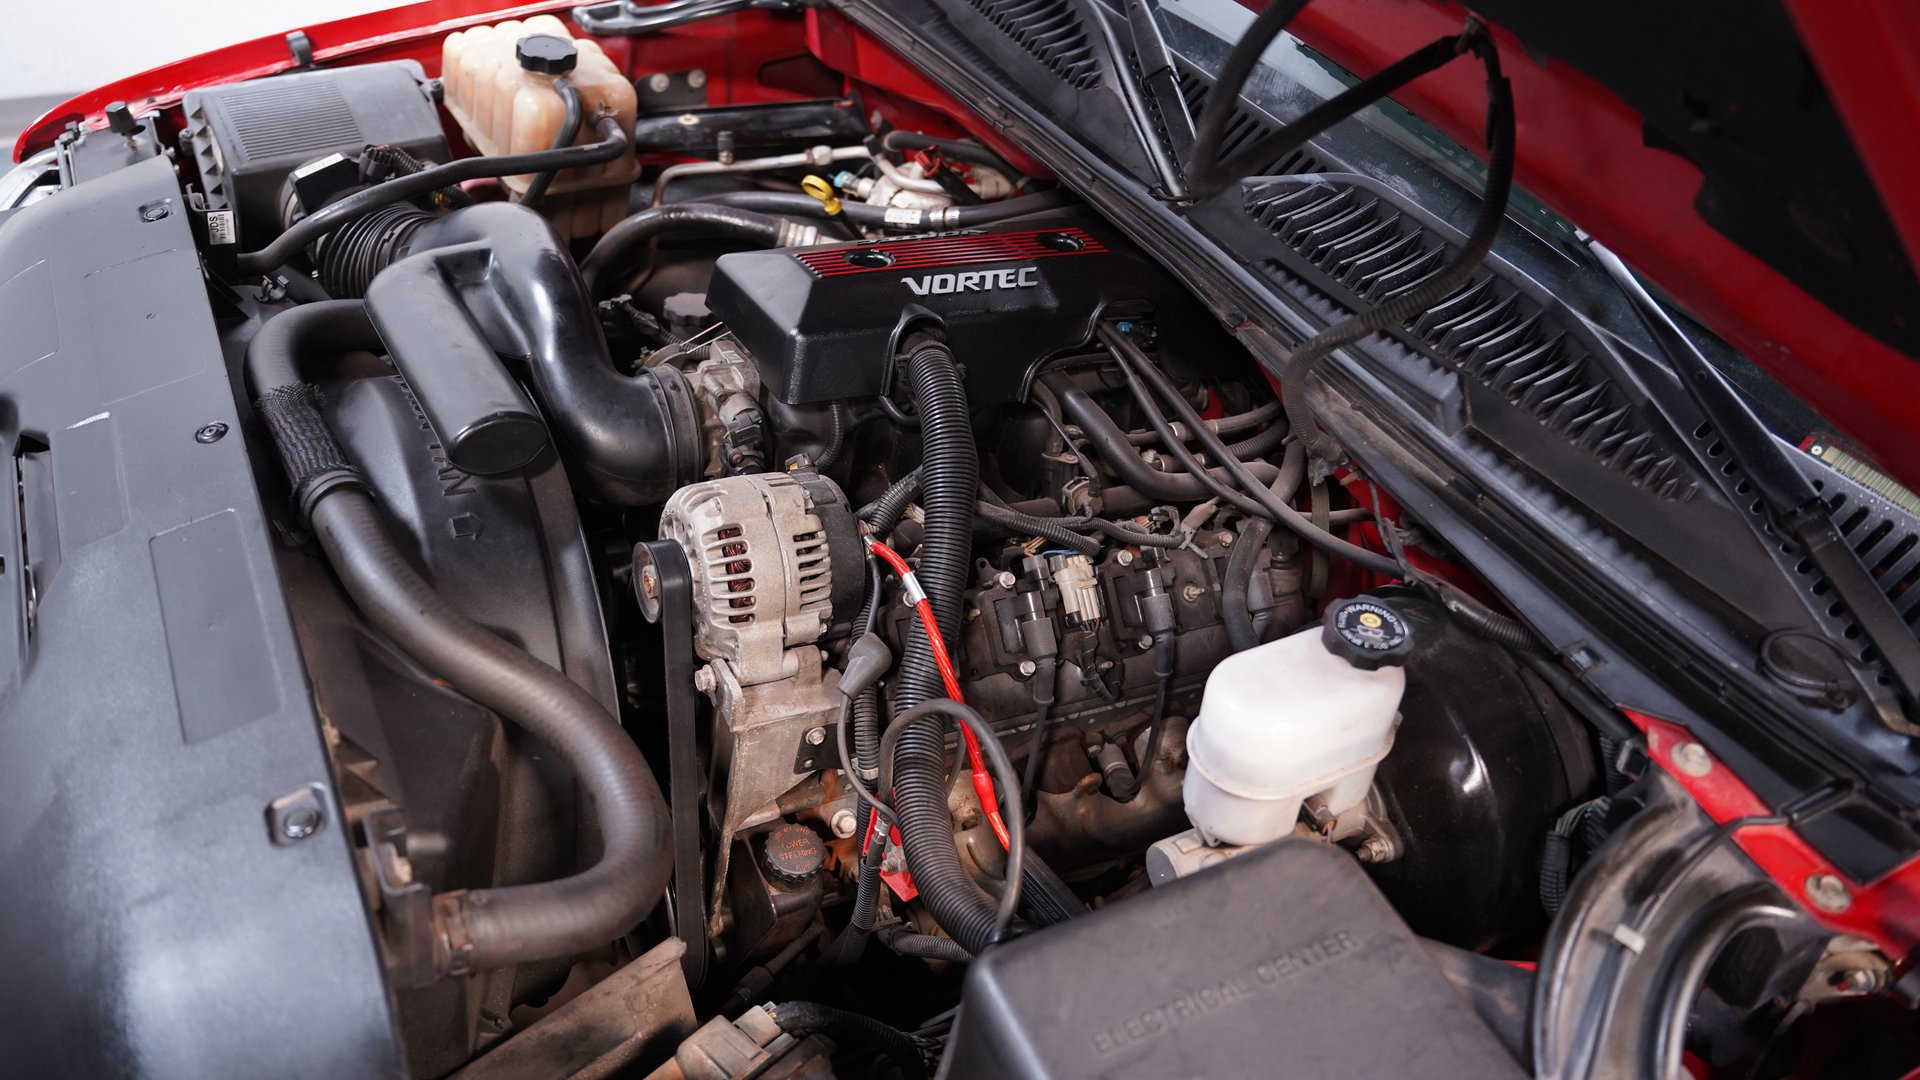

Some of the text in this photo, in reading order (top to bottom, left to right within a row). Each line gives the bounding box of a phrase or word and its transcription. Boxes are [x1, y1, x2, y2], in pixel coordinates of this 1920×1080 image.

[209, 216, 220, 233] JDS
[900, 266, 1039, 296] VORTEC
[1345, 603, 1397, 623] WARNING
[1092, 929, 1359, 1053] ELECTRICAL CENTER
